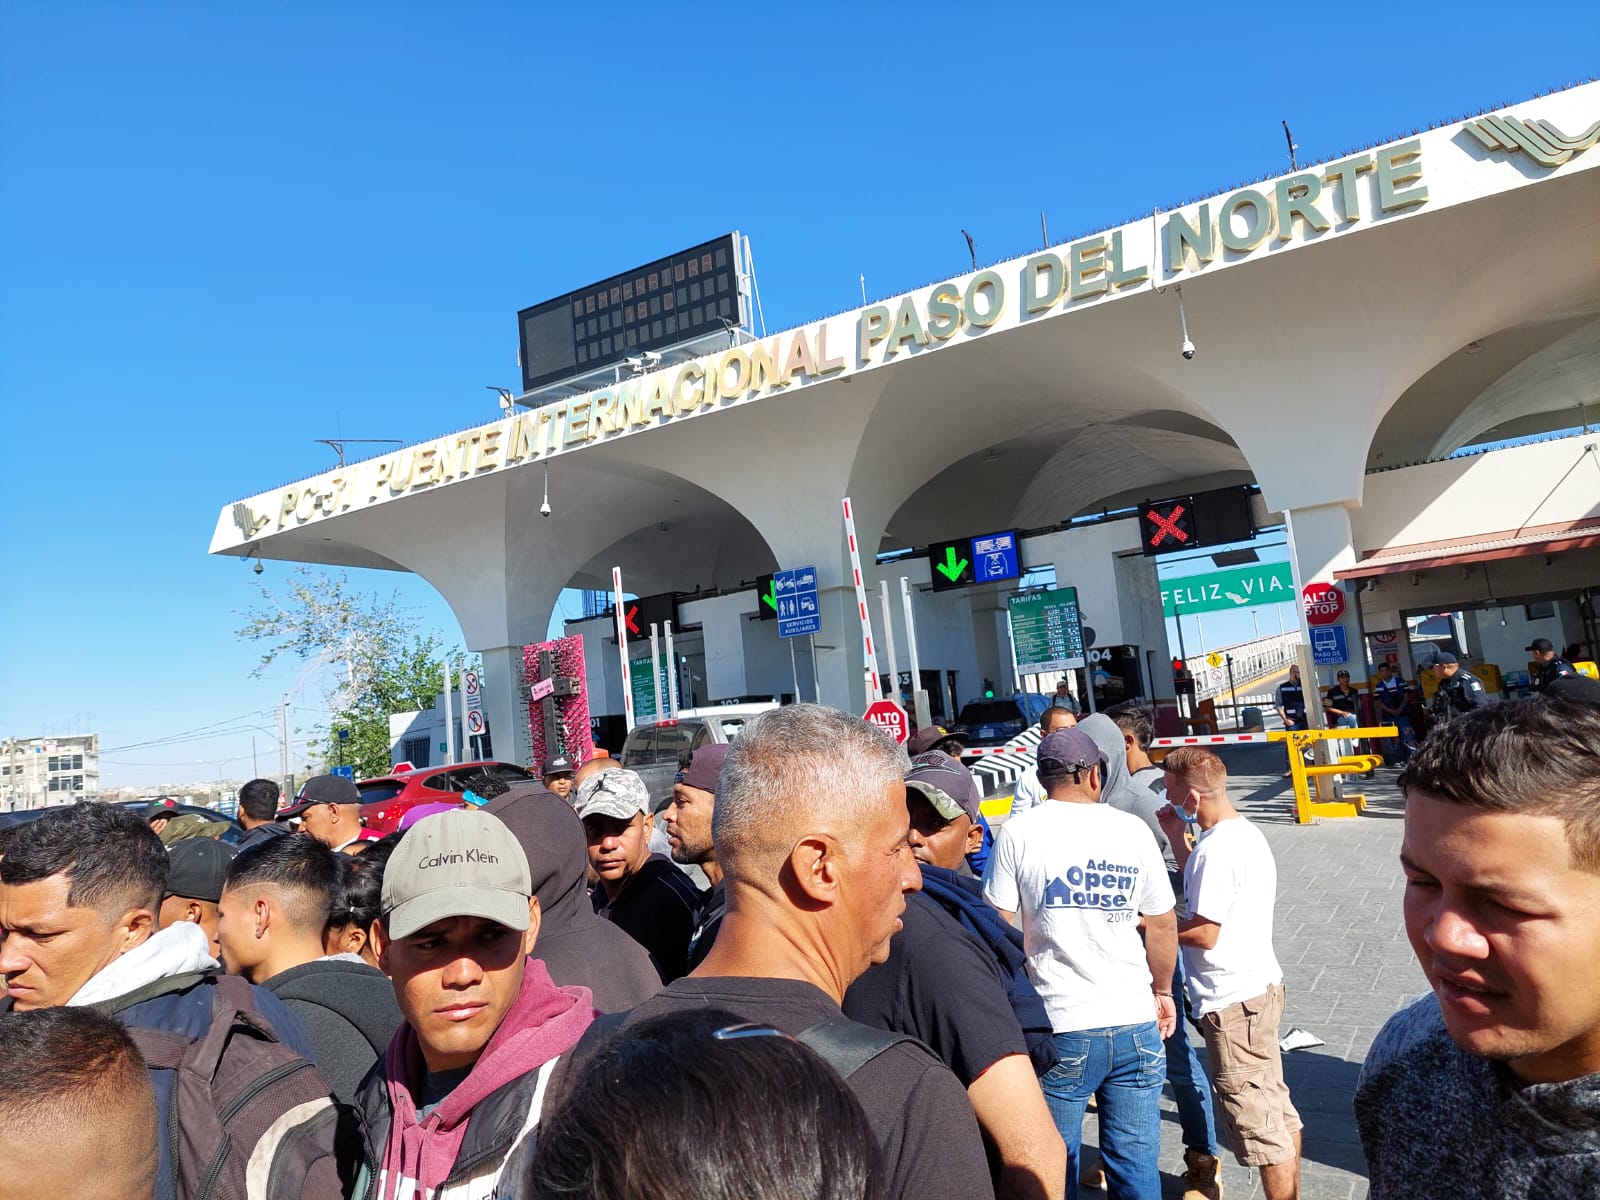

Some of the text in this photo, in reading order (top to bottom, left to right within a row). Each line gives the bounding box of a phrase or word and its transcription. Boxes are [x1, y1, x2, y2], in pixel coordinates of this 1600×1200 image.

[369, 425, 502, 502] PUENTE
[506, 322, 846, 462] INTERNACIONAL
[859, 270, 1005, 363] PASO
[1025, 230, 1149, 314] DEL
[1168, 139, 1429, 272] NORTE
[1161, 575, 1294, 606] FELIZ VIA
[1011, 594, 1041, 604] TARIFAS
[1304, 592, 1337, 604] ALTO
[1304, 604, 1339, 616] STOP
[786, 619, 814, 628] SERVICIOS
[1086, 648, 1112, 662] 104
[590, 718, 600, 728] 01
[870, 712, 900, 725] ALTO
[419, 848, 499, 869] Calvin Klein
[1086, 859, 1139, 875] Ademco
[1066, 866, 1132, 891] Open
[1107, 912, 1133, 923] 2016
